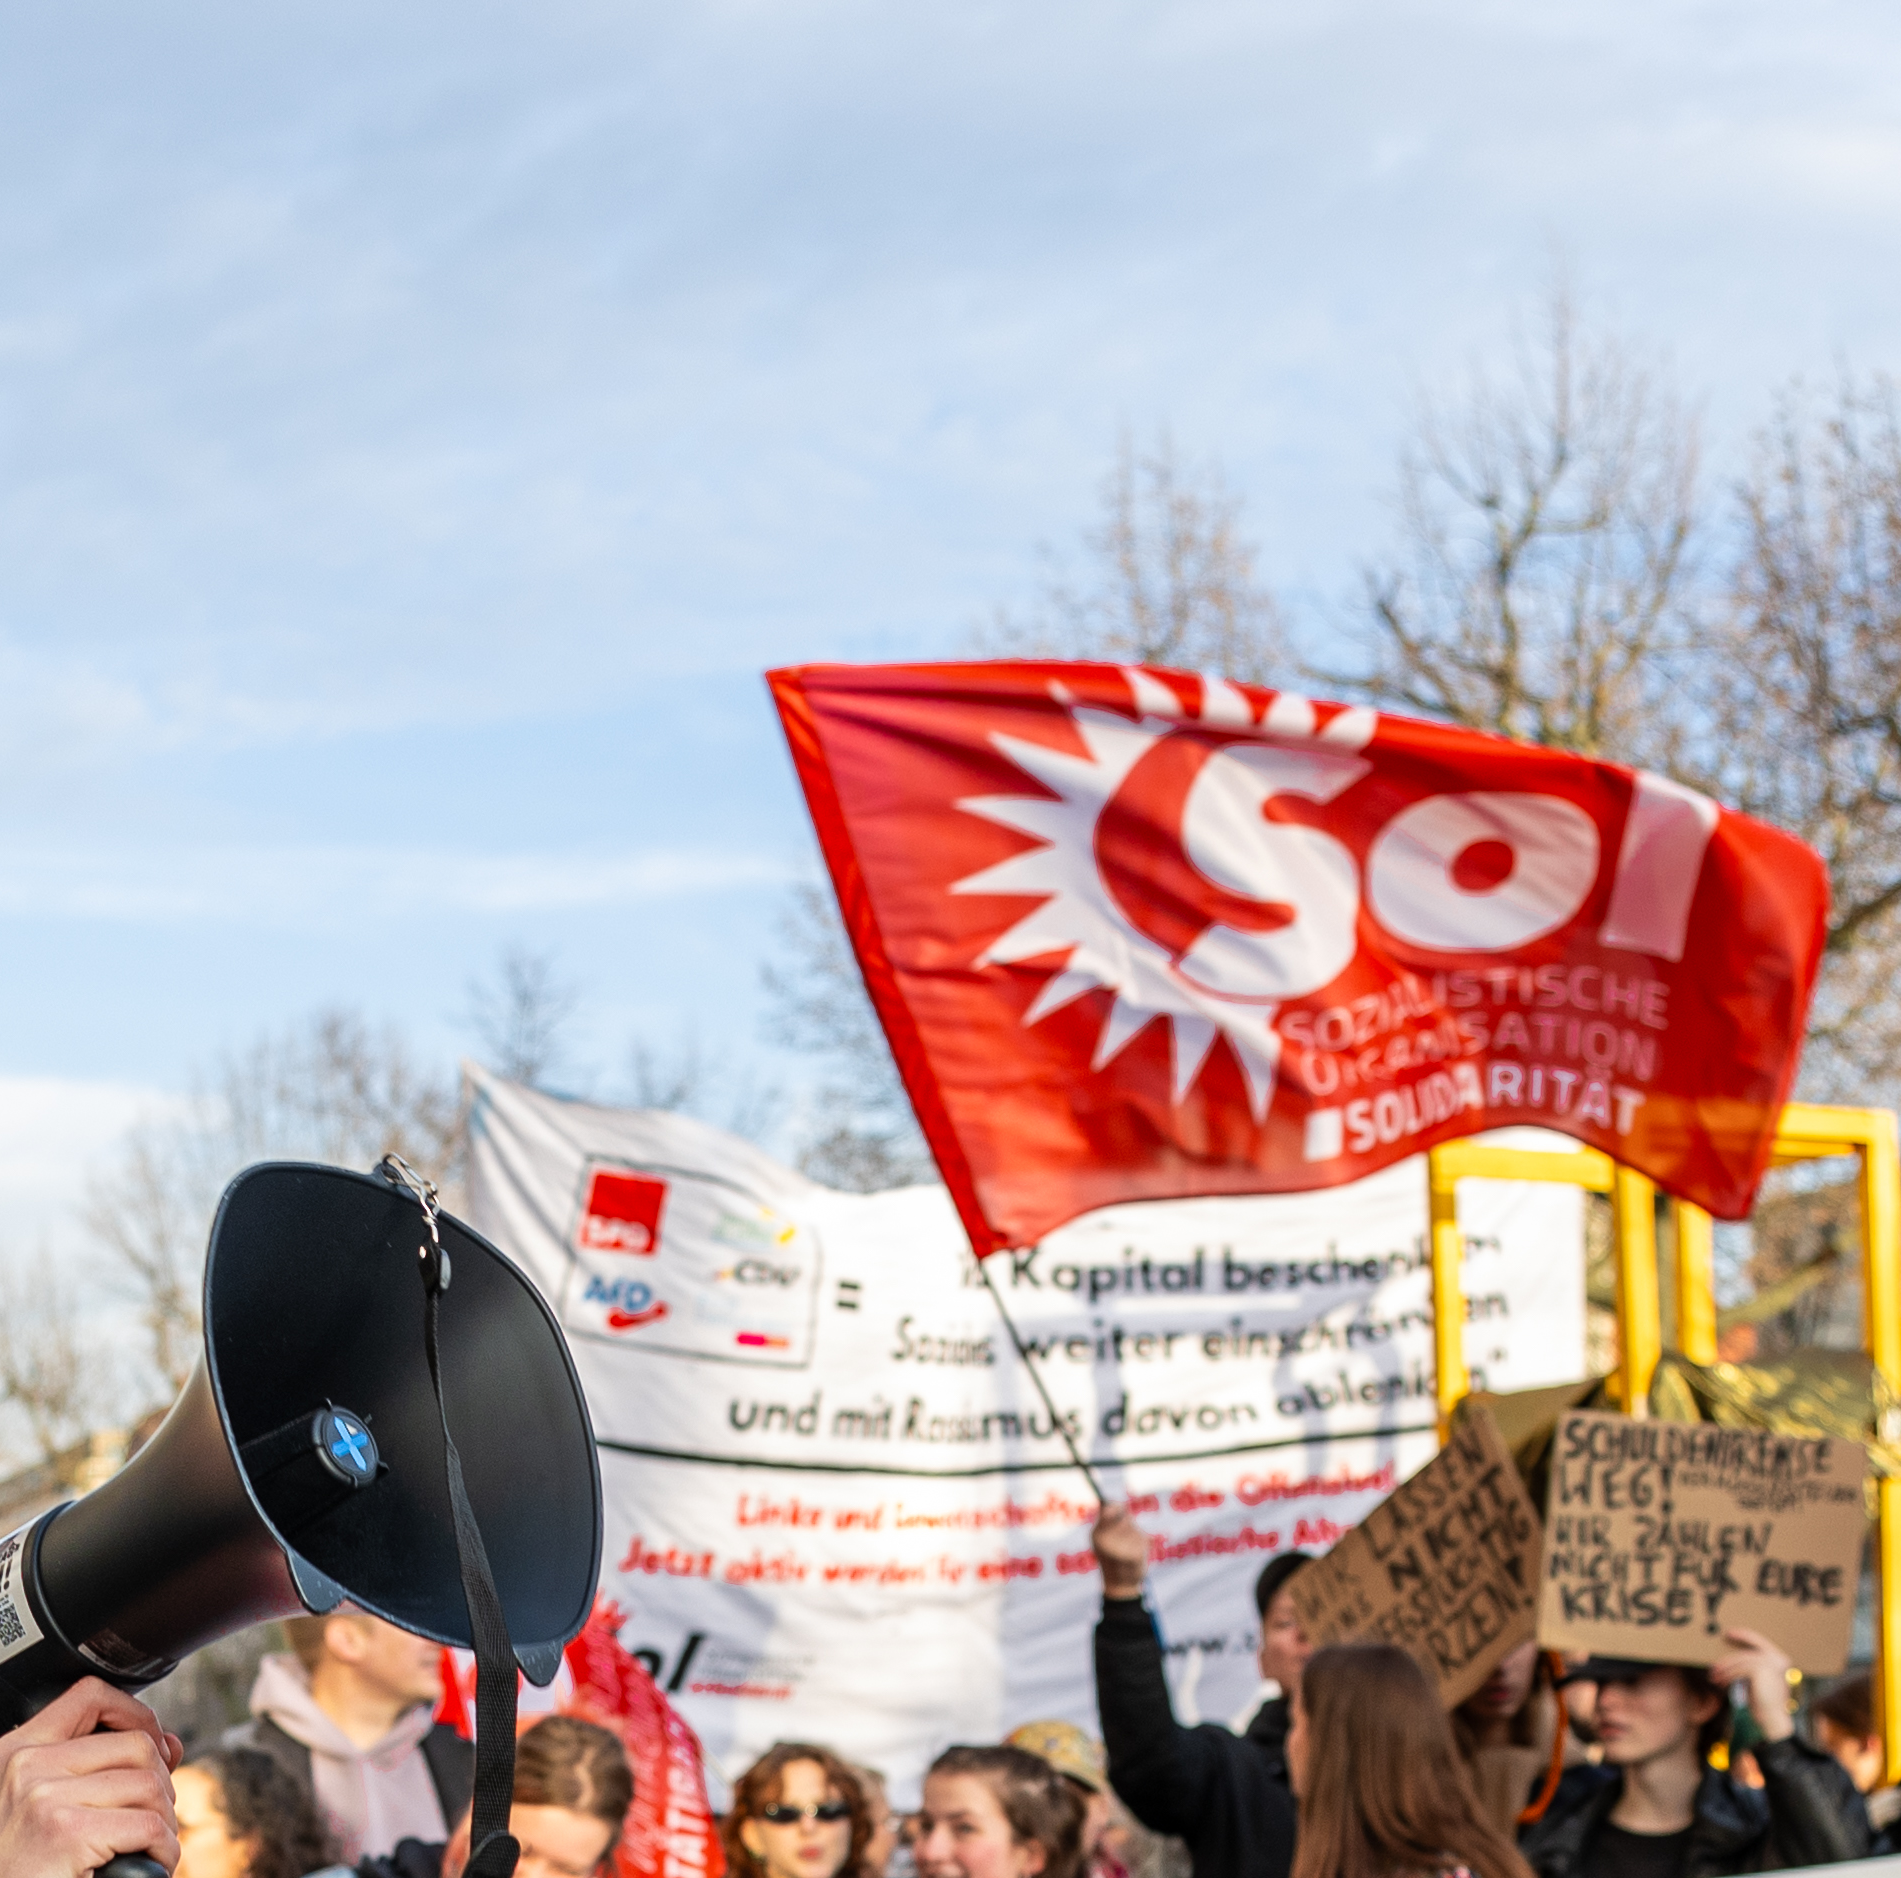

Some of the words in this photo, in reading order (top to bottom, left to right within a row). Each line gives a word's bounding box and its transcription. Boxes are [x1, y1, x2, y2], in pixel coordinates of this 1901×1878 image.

[1345, 1061, 1646, 1153] SOLIDARITÄT
[1010, 1247, 1205, 1303] Kapital
[728, 1390, 822, 1437] und
[831, 1397, 894, 1440] mit
[1101, 1389, 1258, 1438] davon
[1560, 1583, 1722, 1636] KRISE!
